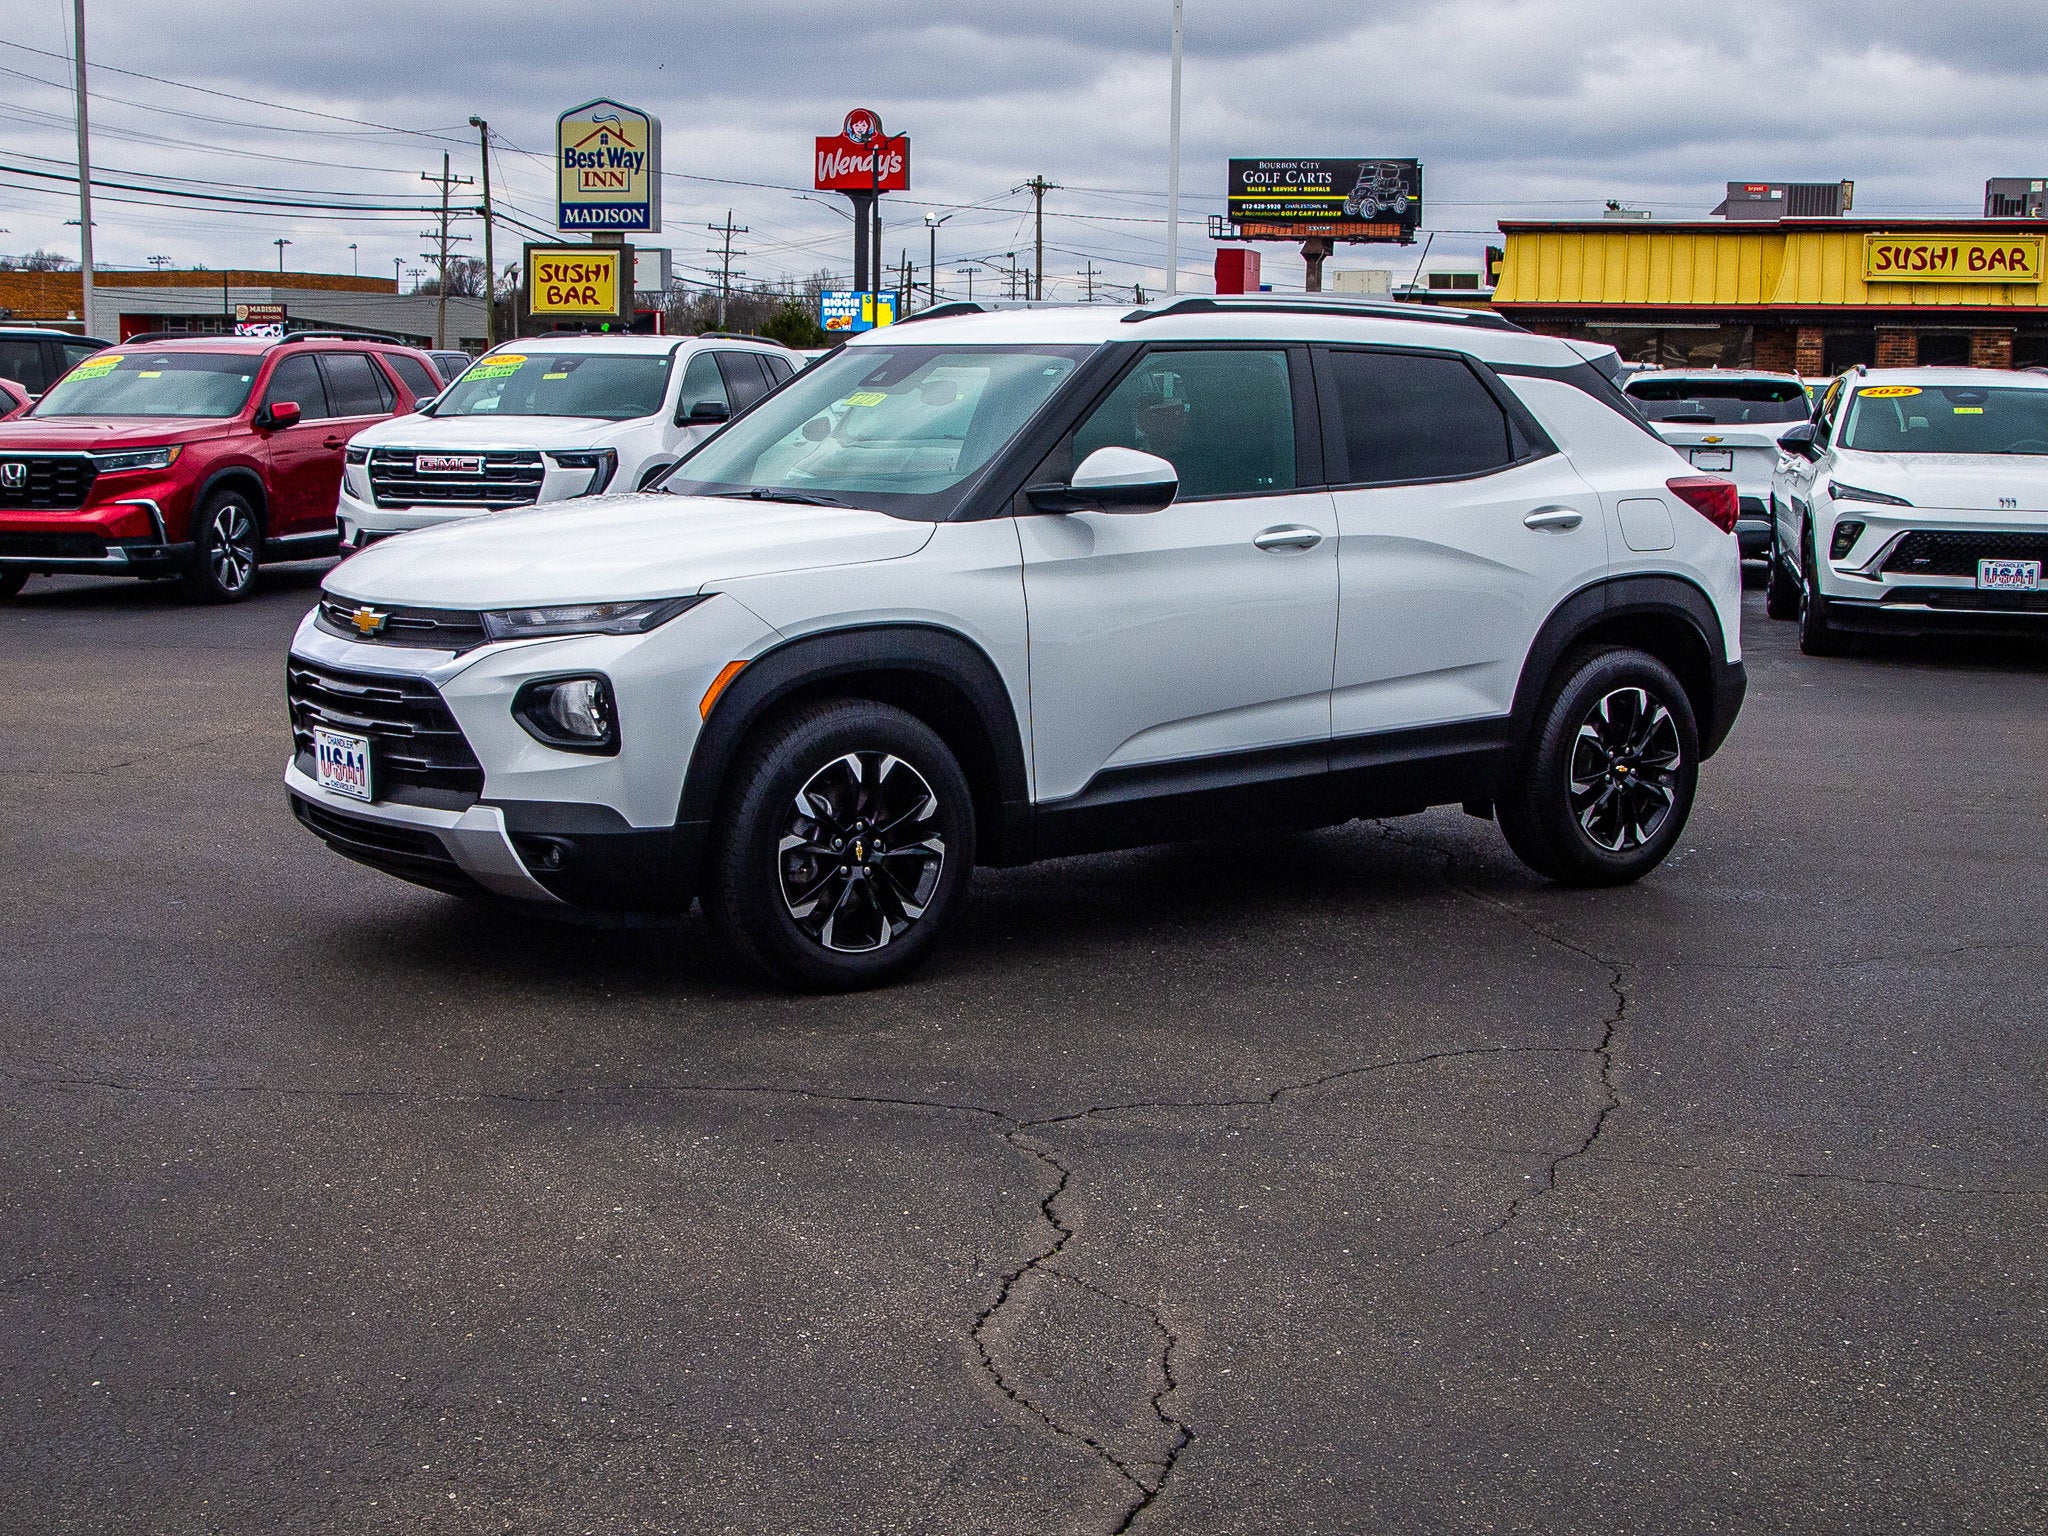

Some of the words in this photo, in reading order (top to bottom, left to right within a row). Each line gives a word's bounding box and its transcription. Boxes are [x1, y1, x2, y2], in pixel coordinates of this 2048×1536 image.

[818, 148, 903, 182] Wendy's
[583, 171, 626, 188] INN
[564, 208, 645, 223] MADISON
[1876, 246, 1958, 271] SUSHI
[1968, 247, 2031, 272] BAR
[539, 263, 610, 284] SUSHI
[547, 286, 601, 306] BAR
[1866, 388, 1914, 396] 2025
[420, 458, 478, 471] GMC
[327, 735, 354, 750] CHANDLER
[330, 780, 356, 792] CHEVROLET
